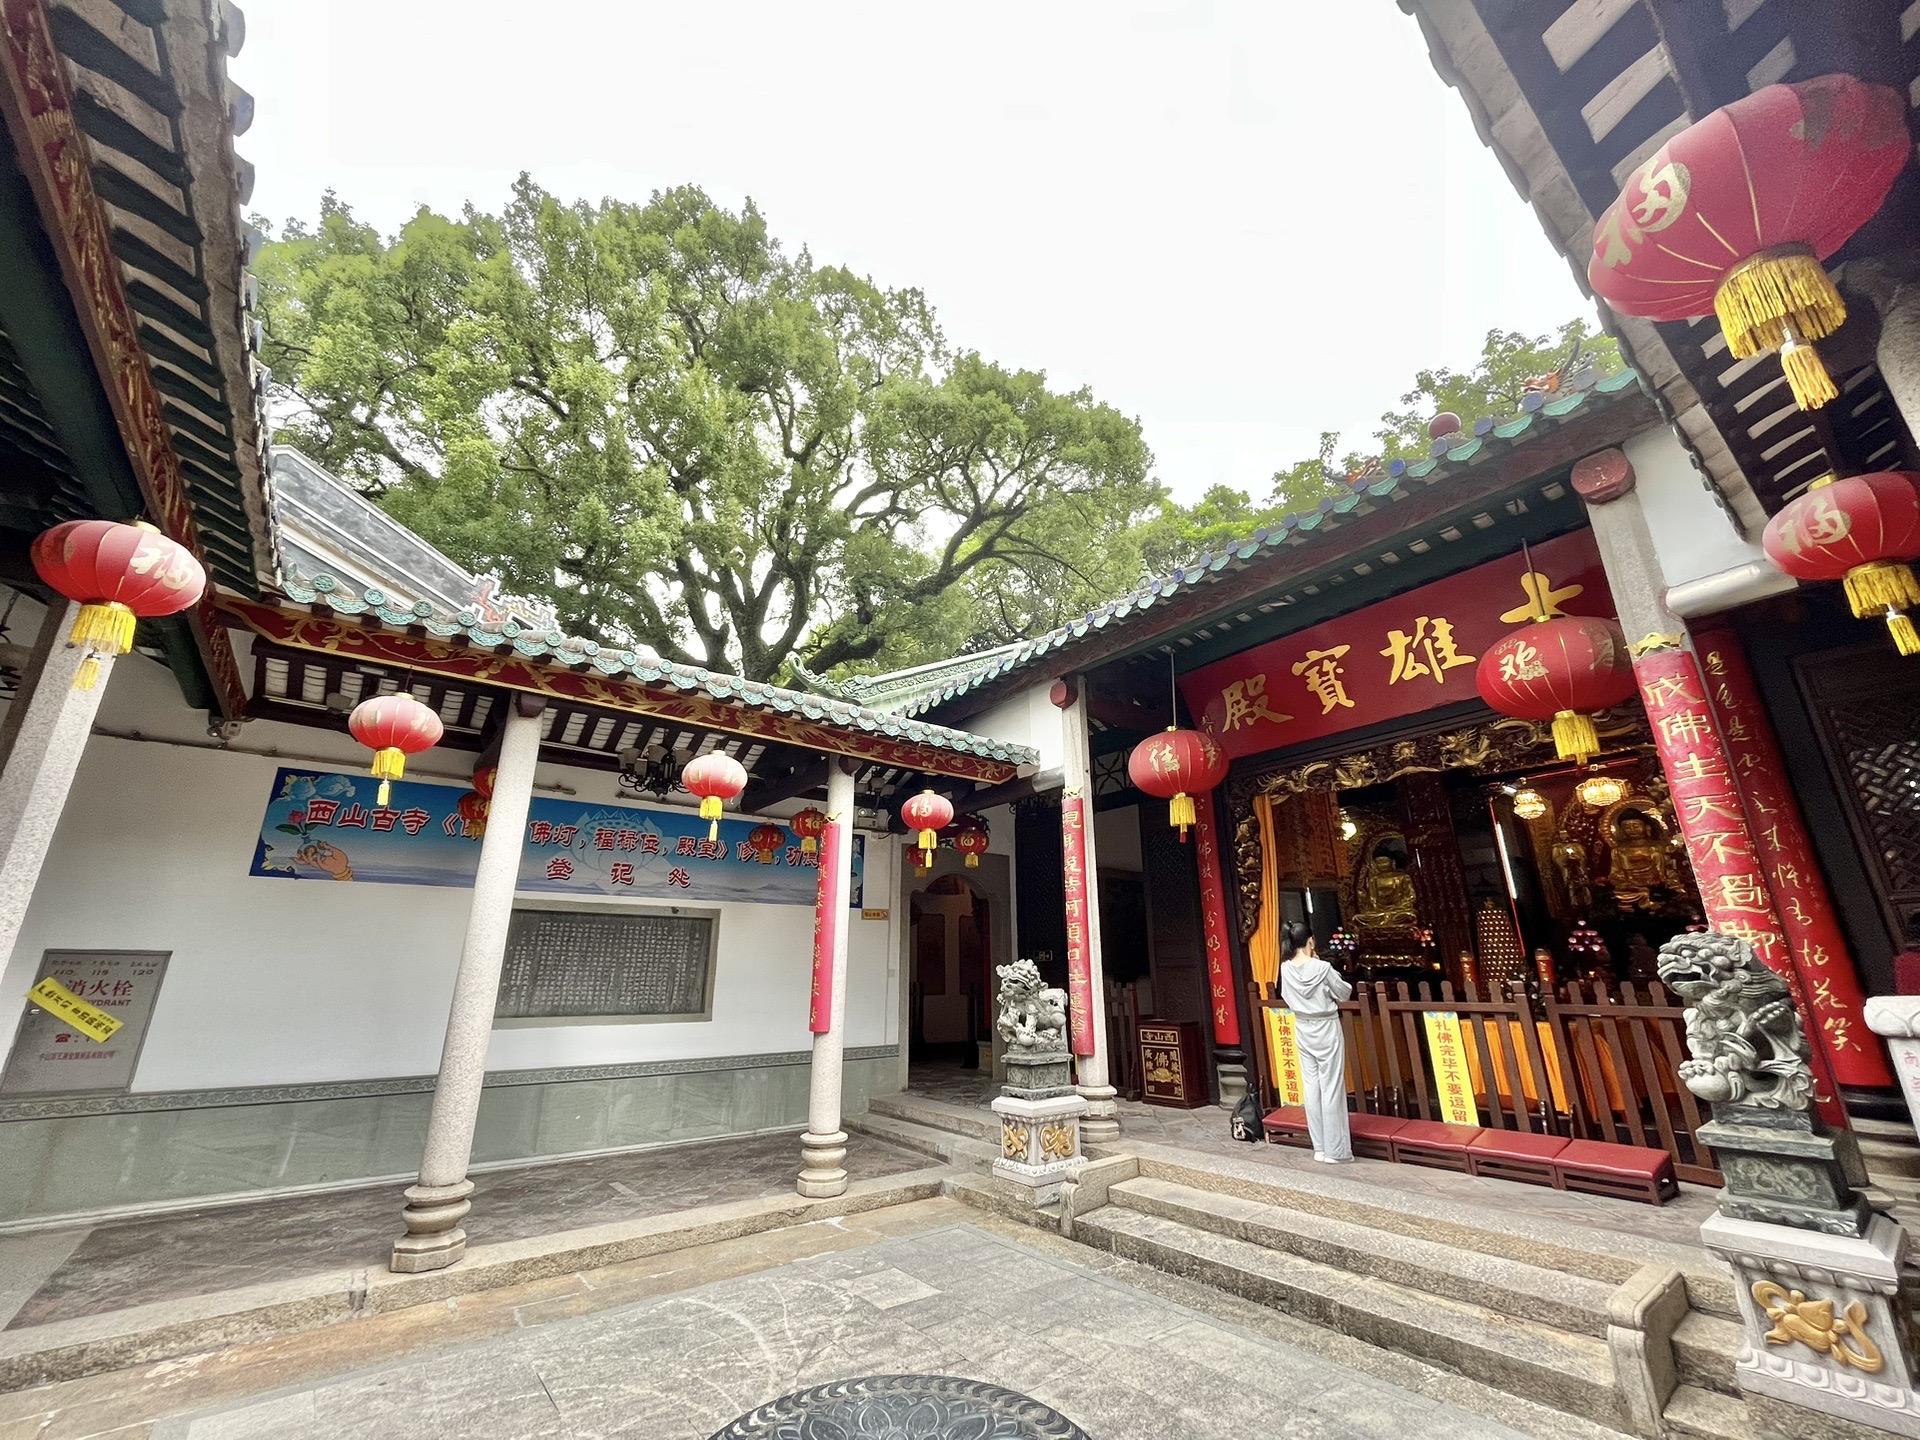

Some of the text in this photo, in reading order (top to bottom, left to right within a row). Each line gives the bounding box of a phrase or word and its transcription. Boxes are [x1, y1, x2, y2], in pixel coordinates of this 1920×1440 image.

[546, 857, 691, 889] 登记处
[66, 979, 135, 997] 消火栓
[1153, 1050, 1170, 1069] 佛
[1277, 1014, 1300, 1104] 礼佛完毕不要逗留
[1434, 1019, 1468, 1123] 礼佛完毕不要逗留
